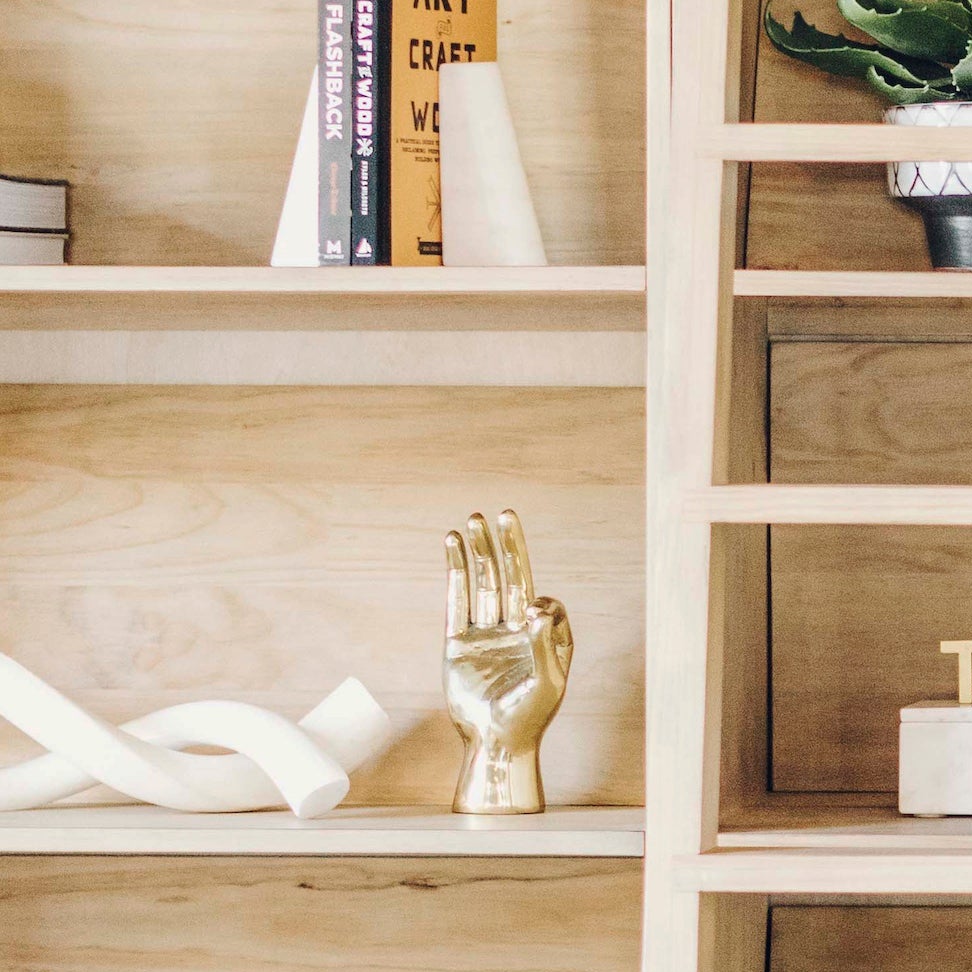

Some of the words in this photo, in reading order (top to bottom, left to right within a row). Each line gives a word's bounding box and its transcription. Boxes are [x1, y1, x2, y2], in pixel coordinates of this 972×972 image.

[356, 0, 373, 66] CRAFT
[409, 38, 476, 71] CRAFT
[325, 4, 343, 140] FLASHBACK
[356, 78, 373, 136] WOOD
